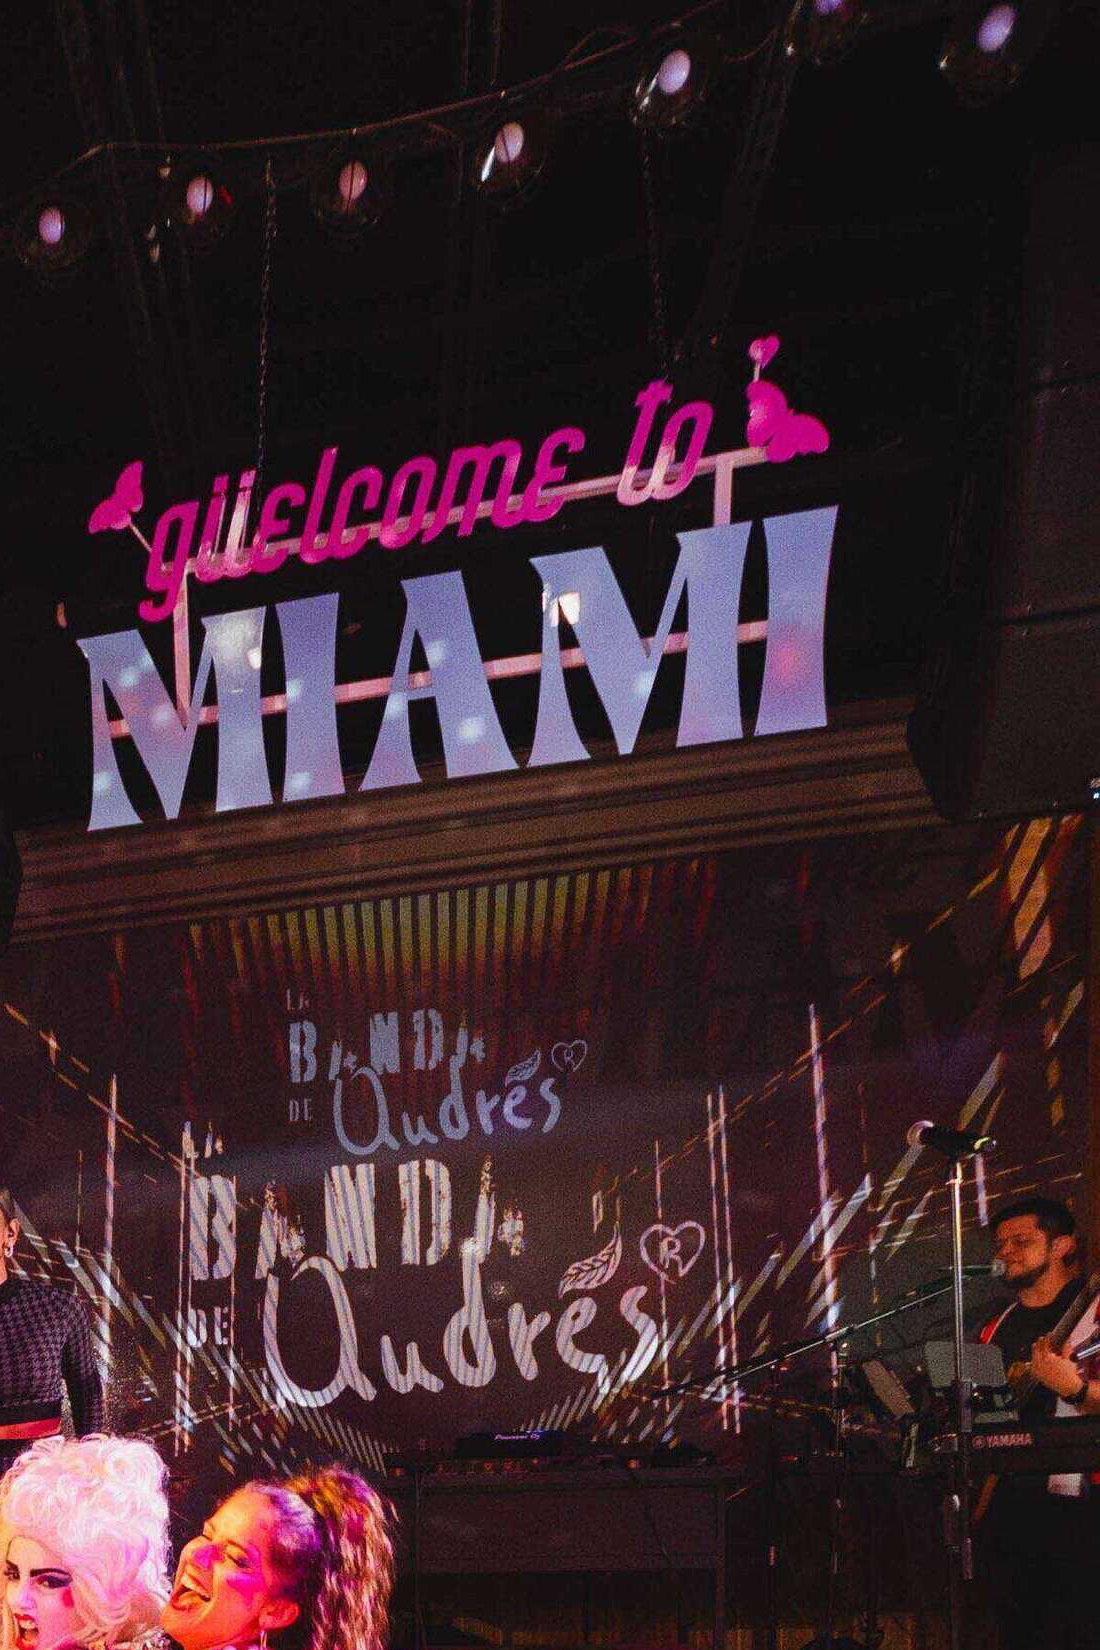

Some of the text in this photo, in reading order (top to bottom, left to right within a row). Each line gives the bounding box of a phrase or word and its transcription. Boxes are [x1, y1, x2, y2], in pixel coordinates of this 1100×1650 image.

[138, 379, 713, 622] güelcome to
[76, 505, 840, 831] MIAMI
[288, 1098, 313, 1122] DE
[187, 1305, 229, 1348] DE
